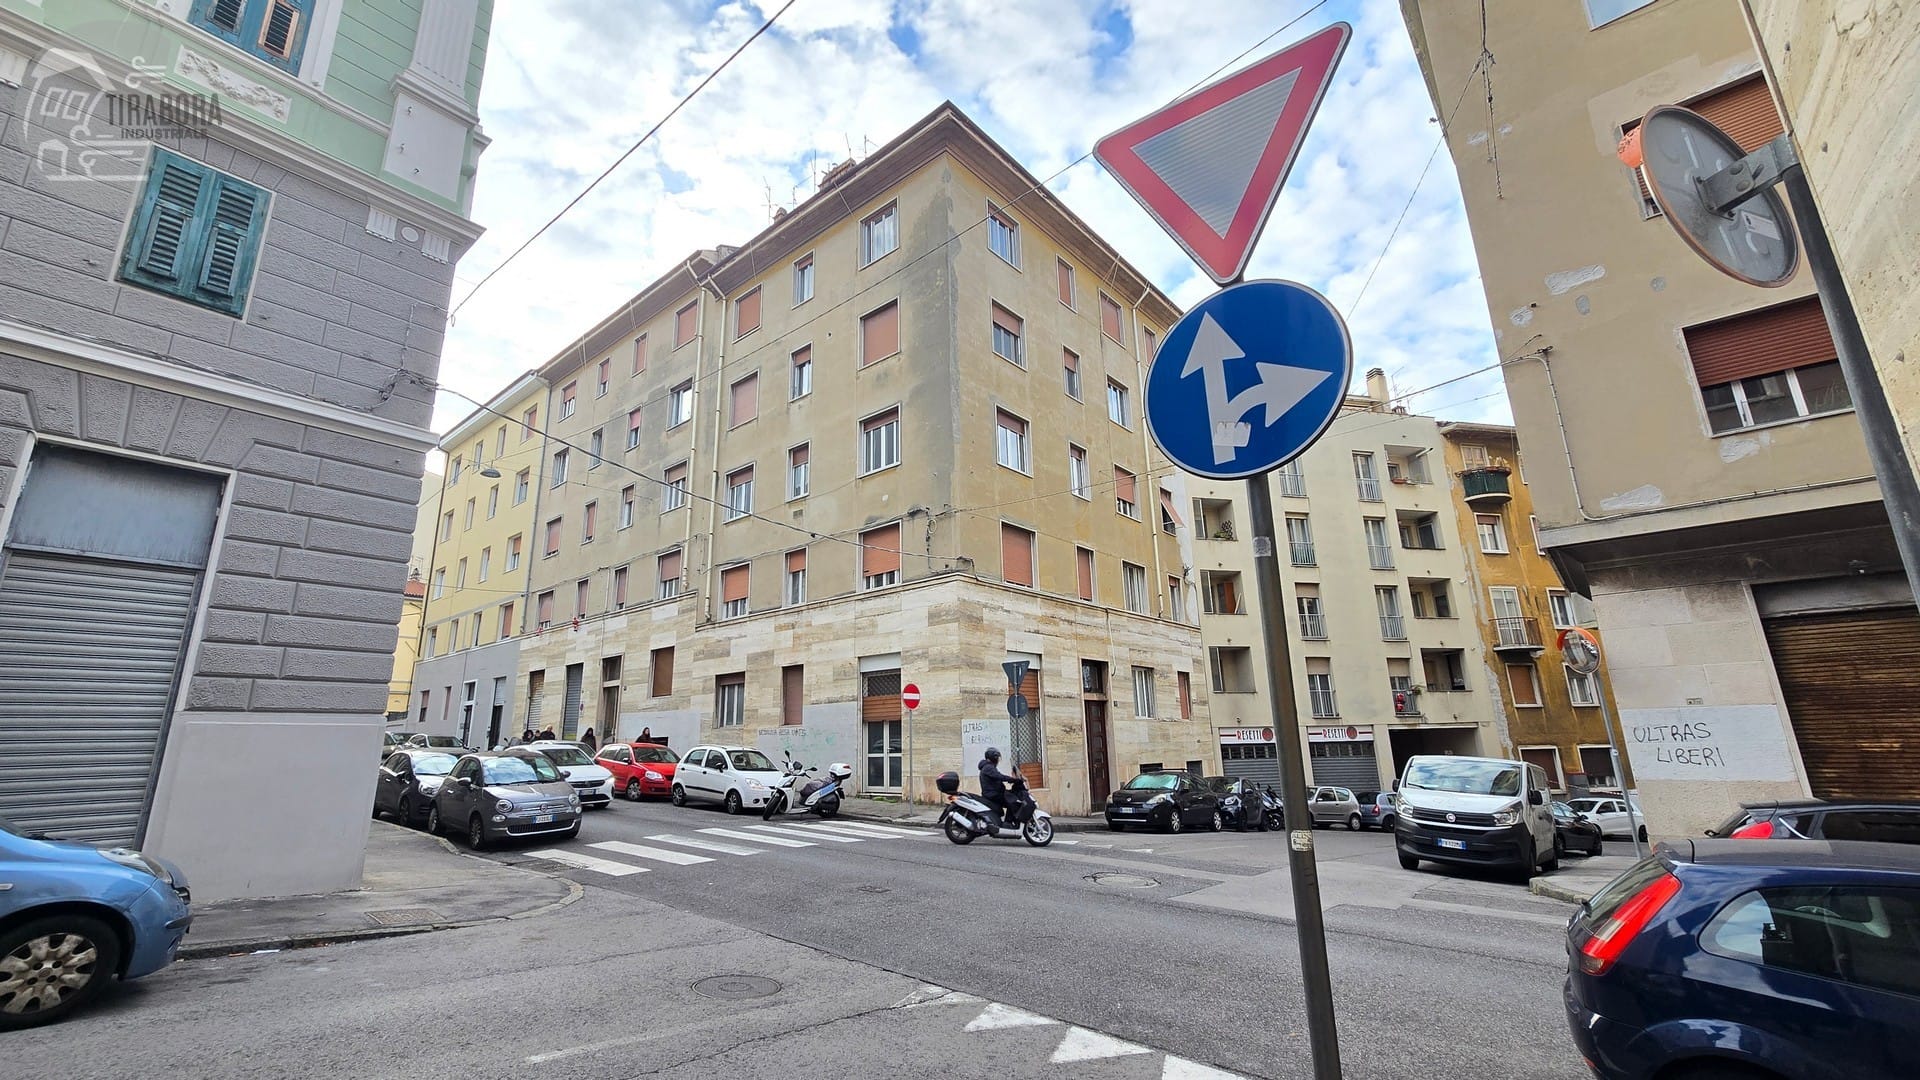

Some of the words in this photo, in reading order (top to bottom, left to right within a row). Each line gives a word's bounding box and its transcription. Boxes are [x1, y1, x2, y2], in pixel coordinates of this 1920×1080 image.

[1236, 729, 1262, 741] RESETTI
[1322, 728, 1346, 739] RESETTI
[1633, 722, 1711, 743] ULTRAS
[1657, 747, 1725, 767] LIBERI
